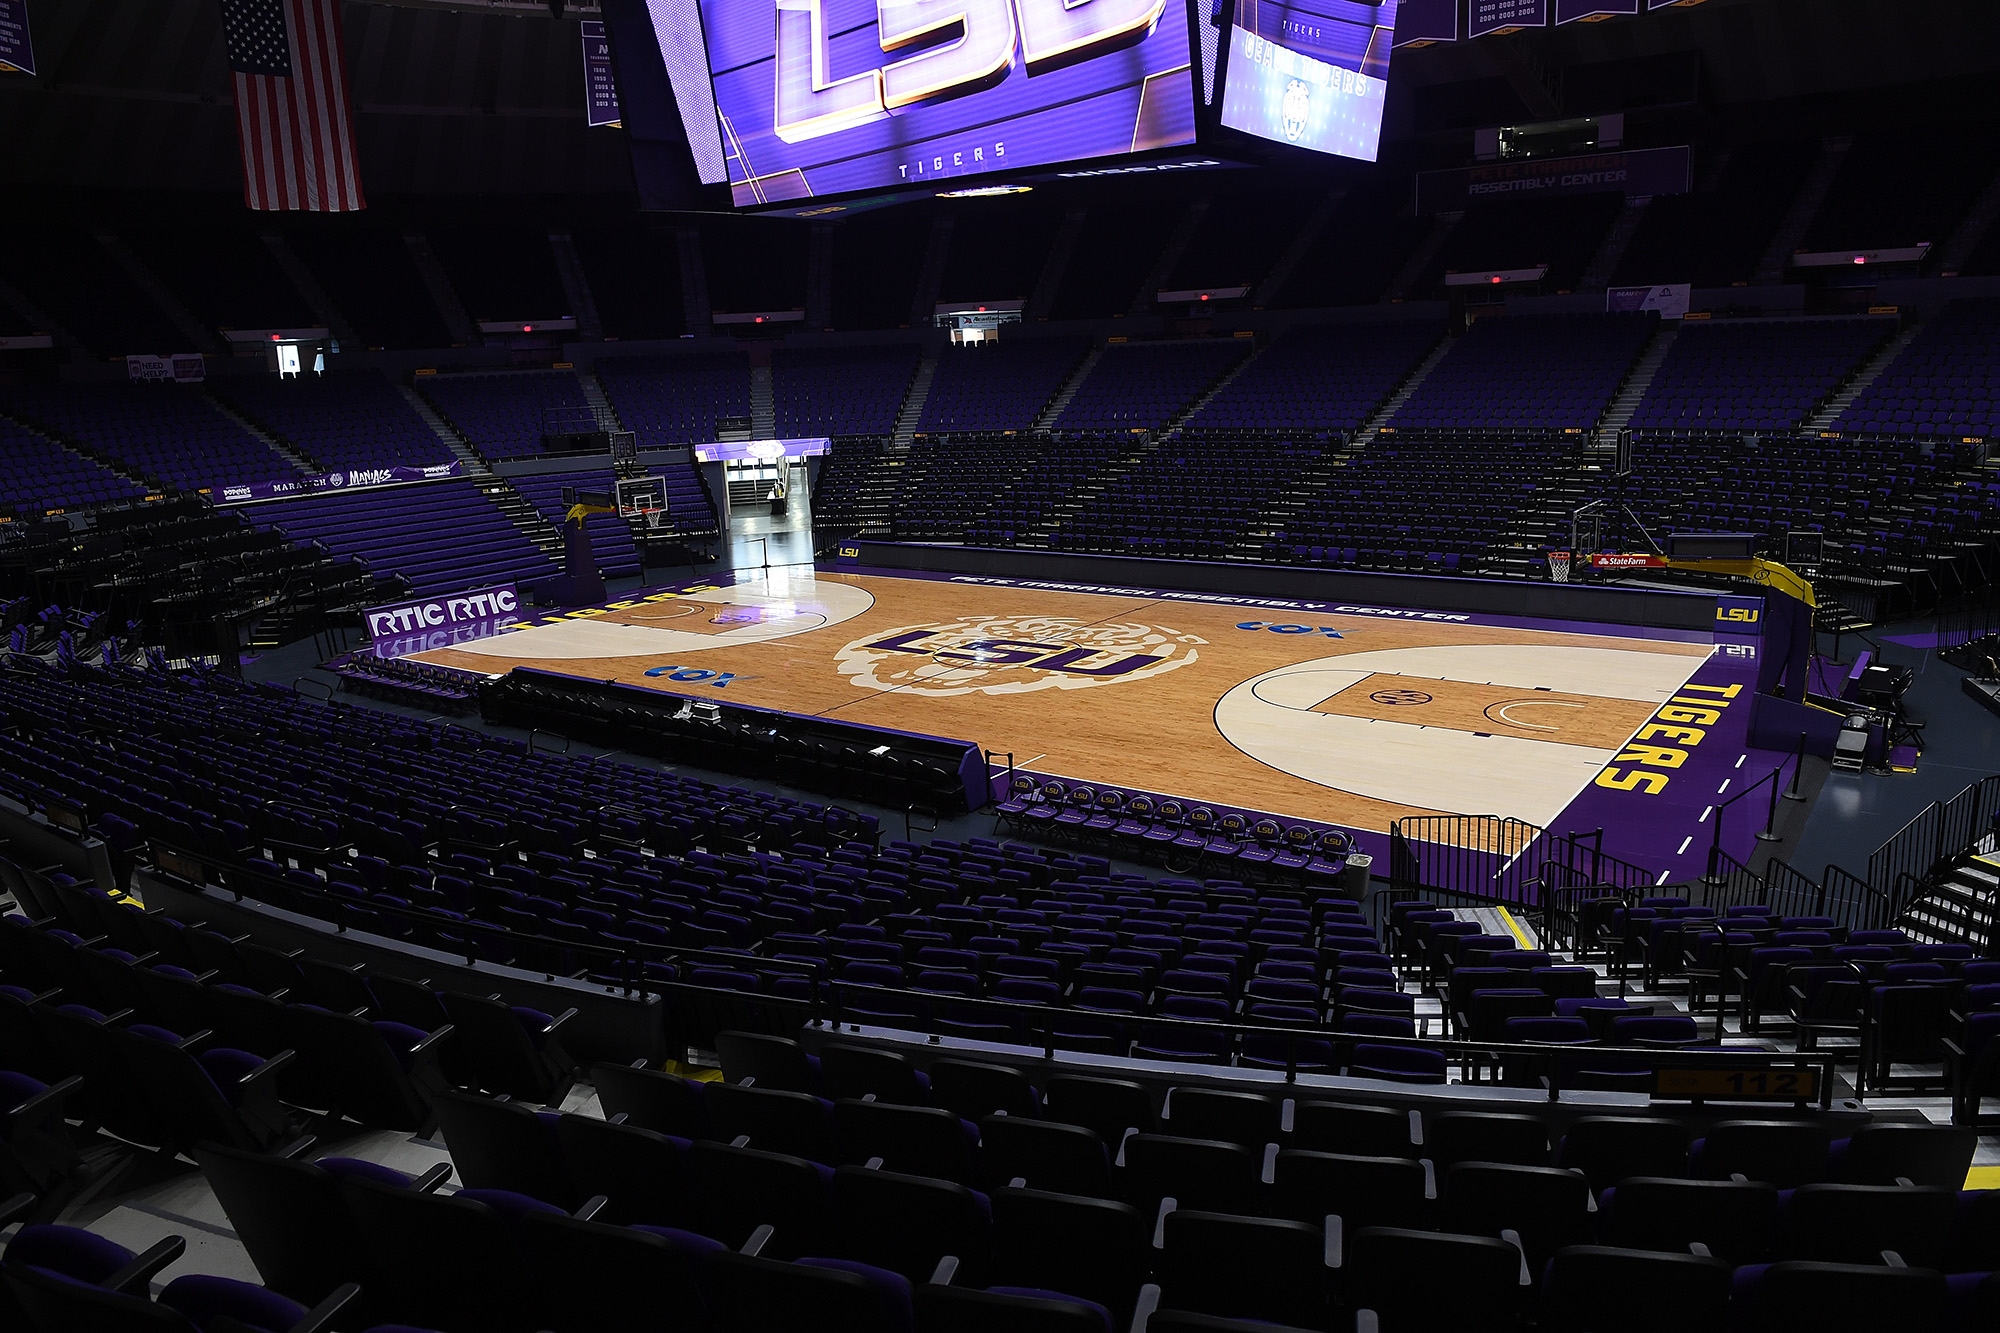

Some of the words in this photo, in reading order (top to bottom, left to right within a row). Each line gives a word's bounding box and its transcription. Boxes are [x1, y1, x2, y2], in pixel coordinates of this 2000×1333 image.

[1480, 14, 1495, 22] 2004
[1282, 20, 1321, 38] TIGERS
[1301, 56, 1368, 97] TIGERS
[899, 142, 1006, 178] TIGERS
[1469, 164, 1518, 181] PETE
[1524, 154, 1628, 177] MARAVICH
[1468, 176, 1556, 195] ASSEMBLY
[1560, 170, 1627, 187] CENTER
[142, 362, 164, 370] NEED
[143, 370, 169, 378] HELP?
[838, 547, 860, 558] LSU
[949, 575, 1016, 585] PETE
[1018, 580, 1157, 597] MARAVICH
[1160, 592, 1327, 610] ASSEMBLY
[1335, 605, 1470, 623] CENTER
[450, 591, 518, 623] RTIC
[369, 603, 447, 637] RTIC
[1715, 606, 1759, 623] LSU
[1235, 621, 1350, 640] COX
[862, 629, 1169, 676] LSU
[643, 665, 748, 688] COX
[1594, 683, 1744, 795] TIGERS
[1014, 781, 1029, 789] LSU
[1045, 786, 1059, 795] LSU
[1073, 792, 1088, 800] LSU
[1101, 796, 1116, 804] LSU
[1132, 802, 1148, 810] LSU
[1161, 806, 1177, 814] LSU
[1192, 812, 1207, 820] LSU
[1223, 819, 1239, 828] LSU
[1257, 826, 1273, 834] LSU
[1290, 831, 1307, 840] LSU
[1324, 837, 1342, 846] LSU
[1726, 1072, 1799, 1094] 112
